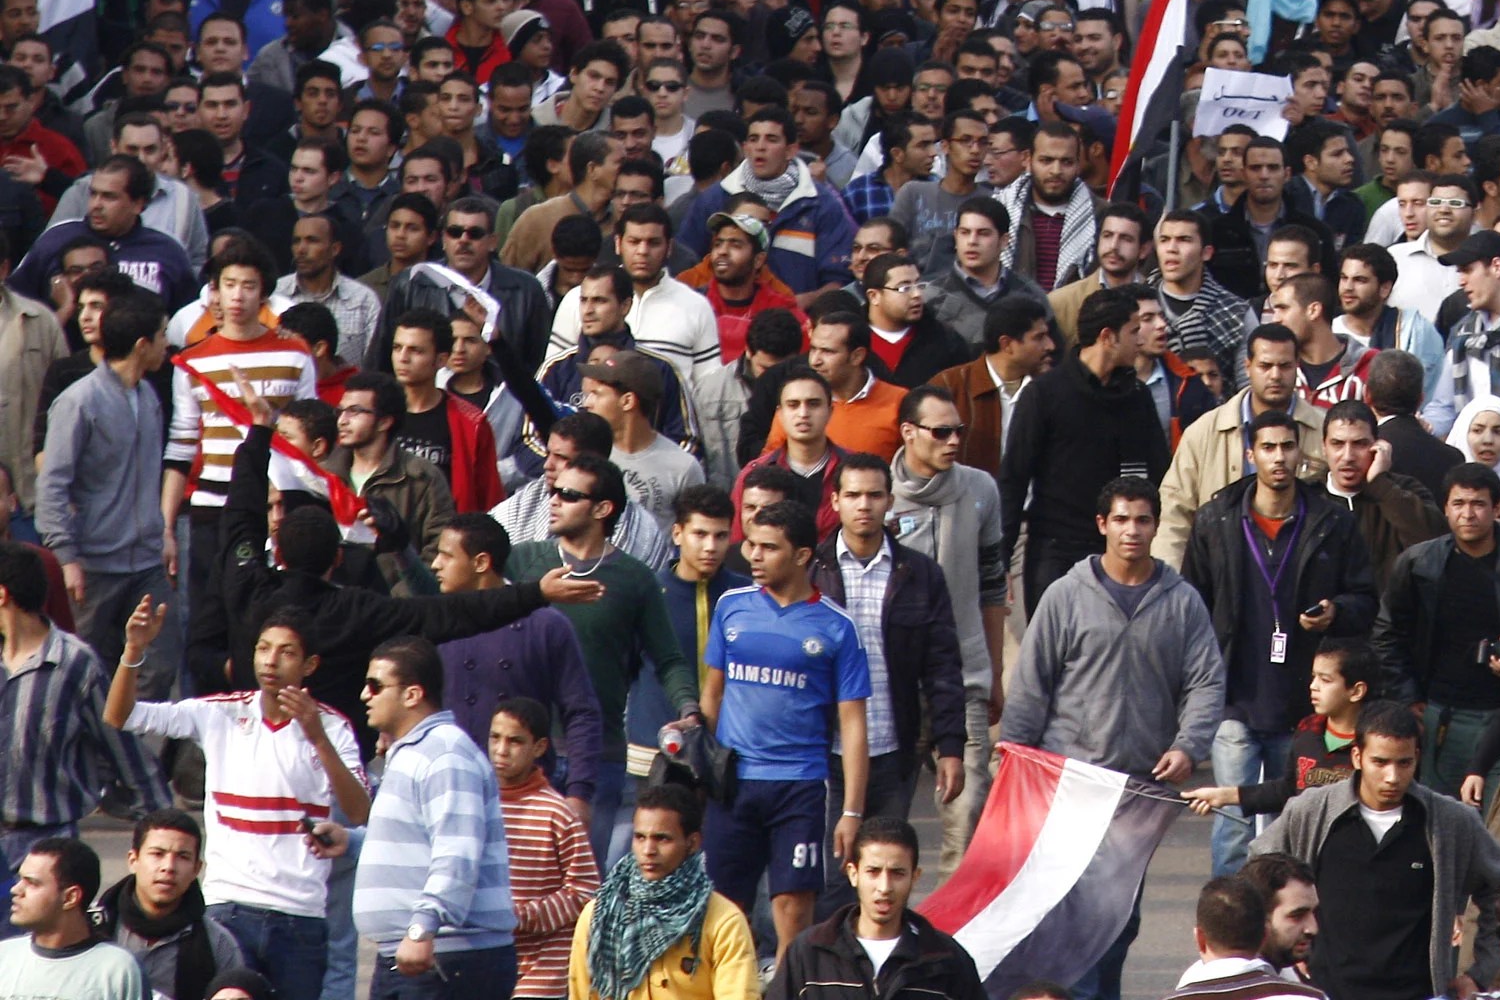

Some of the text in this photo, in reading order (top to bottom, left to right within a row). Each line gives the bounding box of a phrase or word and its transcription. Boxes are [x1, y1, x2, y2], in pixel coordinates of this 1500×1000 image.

[1222, 106, 1265, 120] OUT
[727, 662, 808, 690] SAMSUNG
[792, 842, 817, 869] 91
